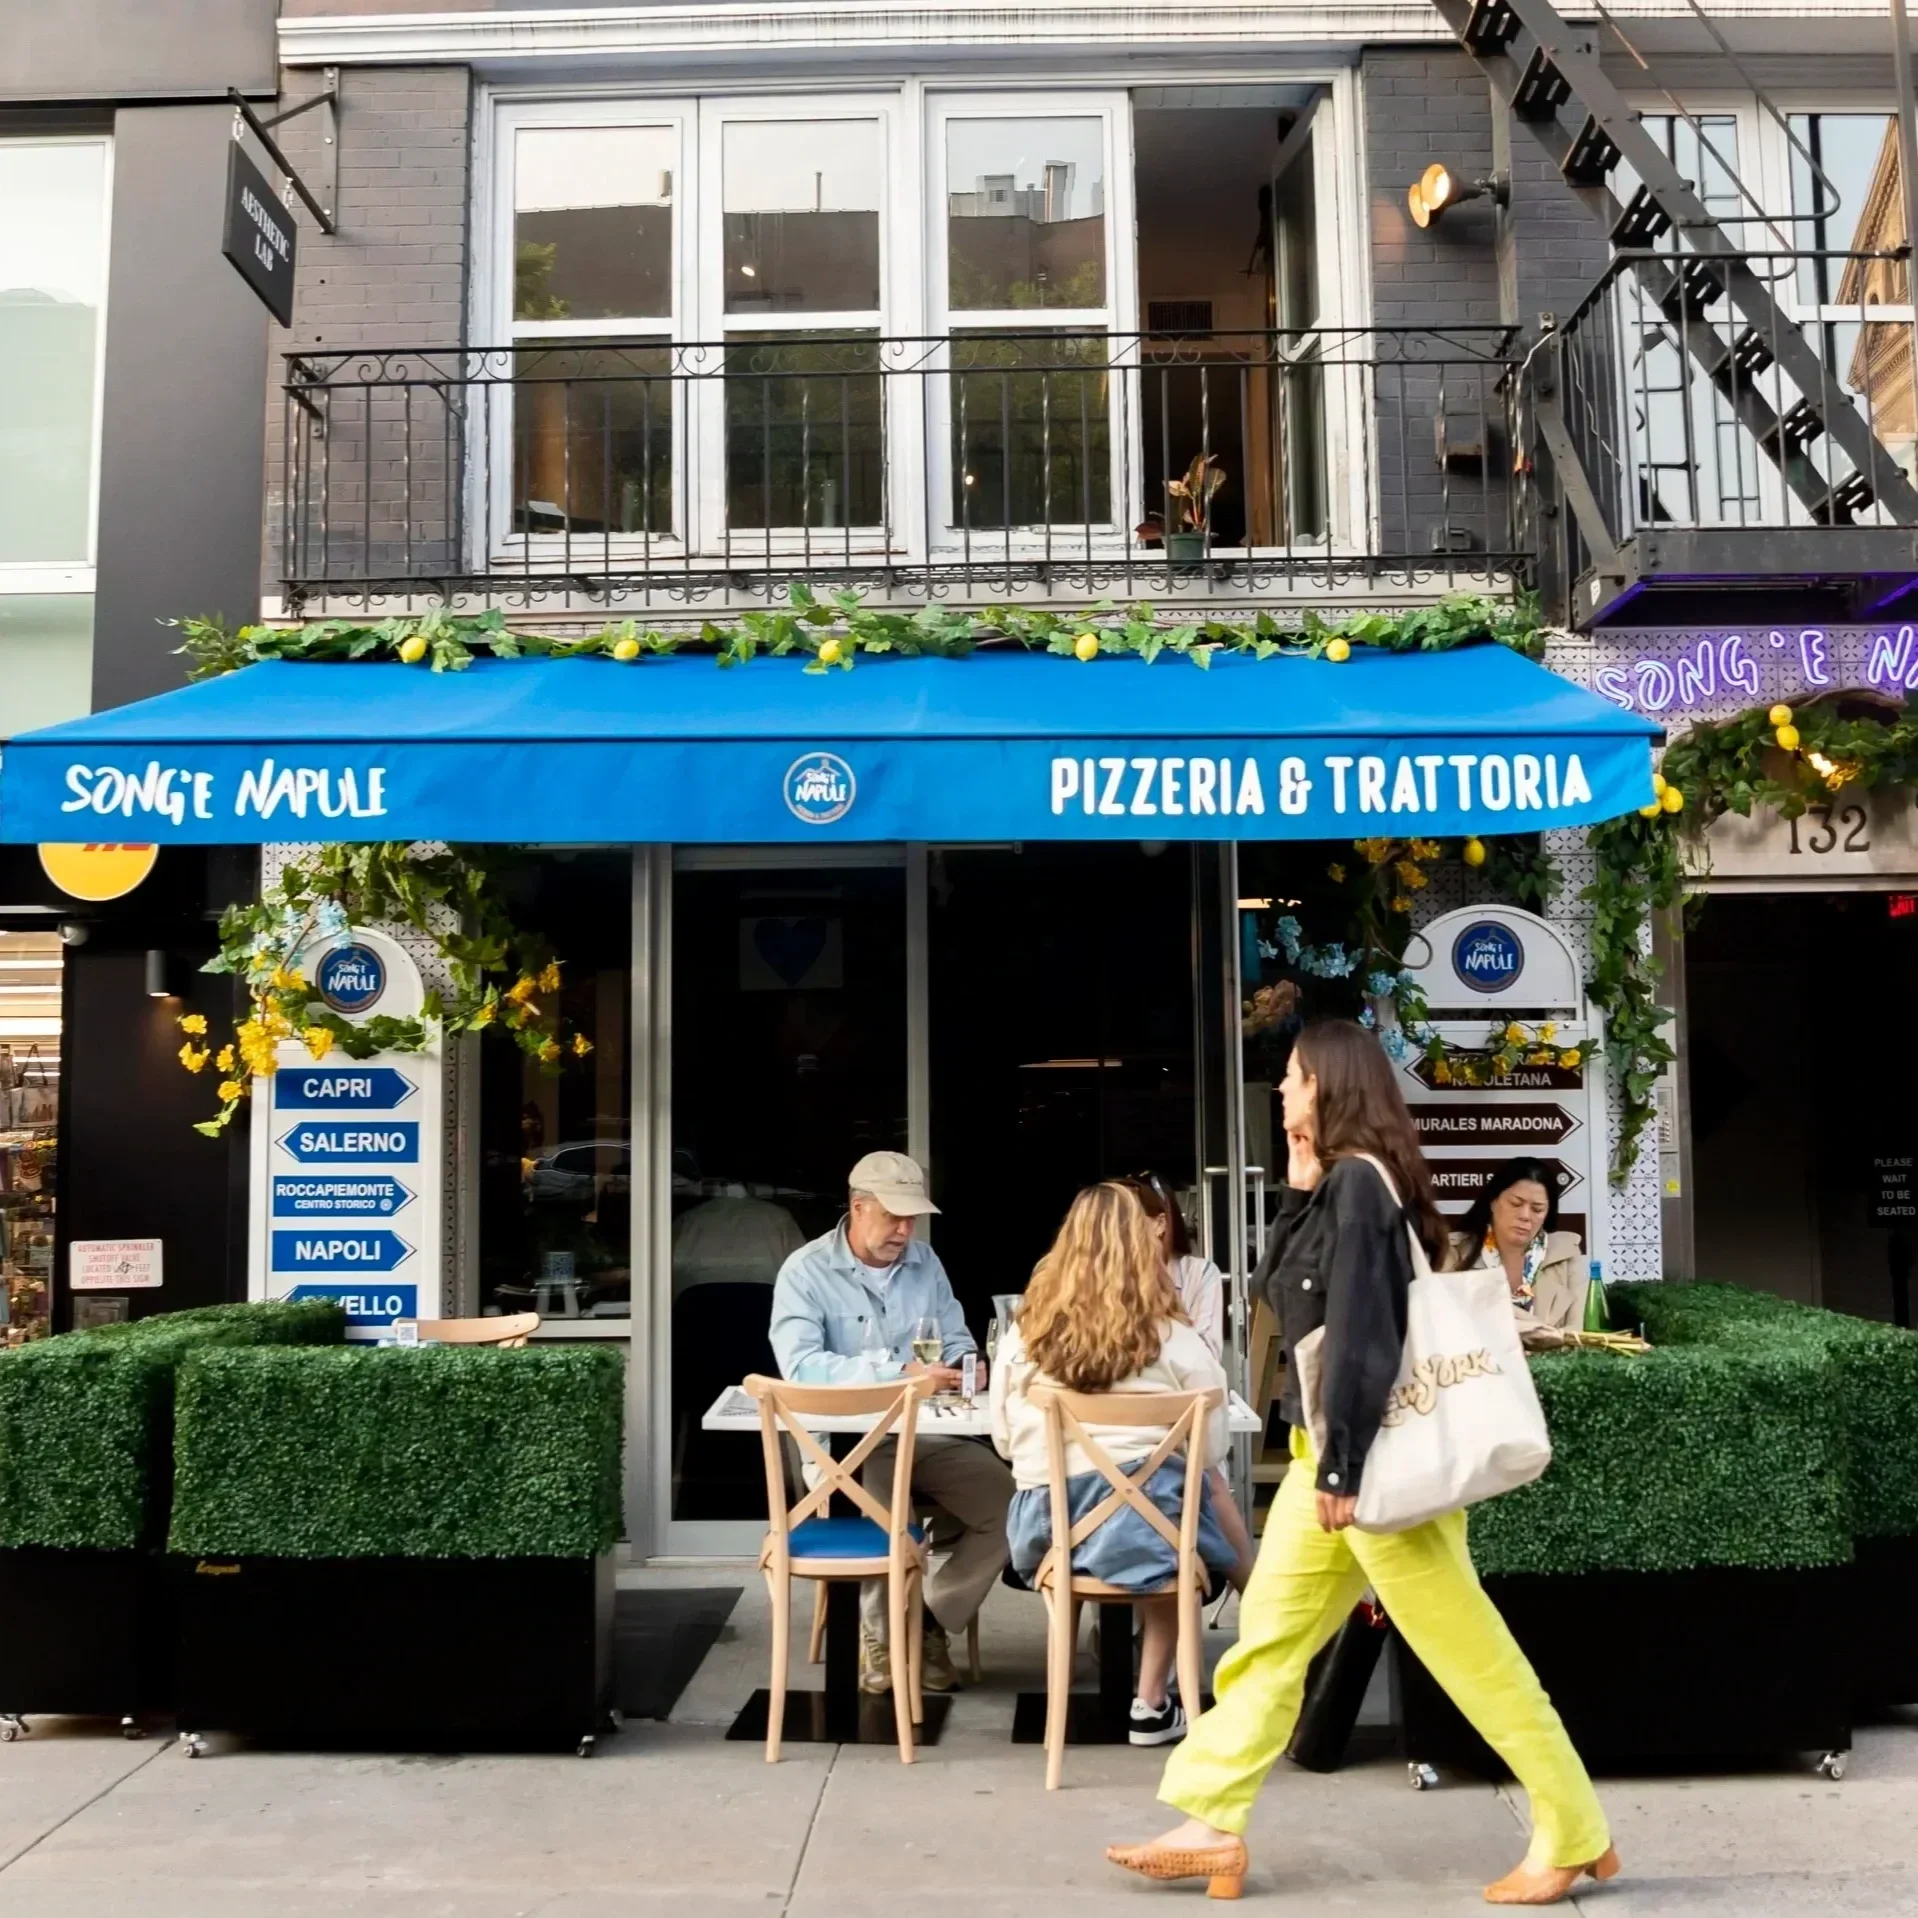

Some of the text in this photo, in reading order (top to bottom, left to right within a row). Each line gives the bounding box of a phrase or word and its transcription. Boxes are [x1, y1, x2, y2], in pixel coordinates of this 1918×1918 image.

[241, 186, 290, 262] AESTHETIC
[254, 233, 273, 272] LAB
[234, 758, 388, 819] NAPULE
[795, 780, 847, 802] NAPULE
[1051, 754, 1593, 815] PIZZERIA & TRATTORIA
[1788, 804, 1871, 854] 132
[1465, 951, 1514, 971] NAPULE
[328, 971, 377, 991] NAPULE
[303, 1078, 372, 1098] CAPRI
[1410, 1117, 1563, 1131] MURALES MARADONA
[300, 1132, 407, 1152] SALERNO
[1874, 1157, 1914, 1168] PLEASE
[1430, 1173, 1484, 1187] ARTIERI
[1882, 1174, 1907, 1184] WAIT
[276, 1184, 395, 1197] ROCCAPIEMONTE
[1881, 1190, 1911, 1200] TO BE
[294, 1200, 376, 1210] CENTRO STORICO
[1877, 1206, 1917, 1216] SEATED
[78, 1242, 154, 1252] AUTOMATIC SPRINKLER
[295, 1240, 381, 1260] NAPOLI
